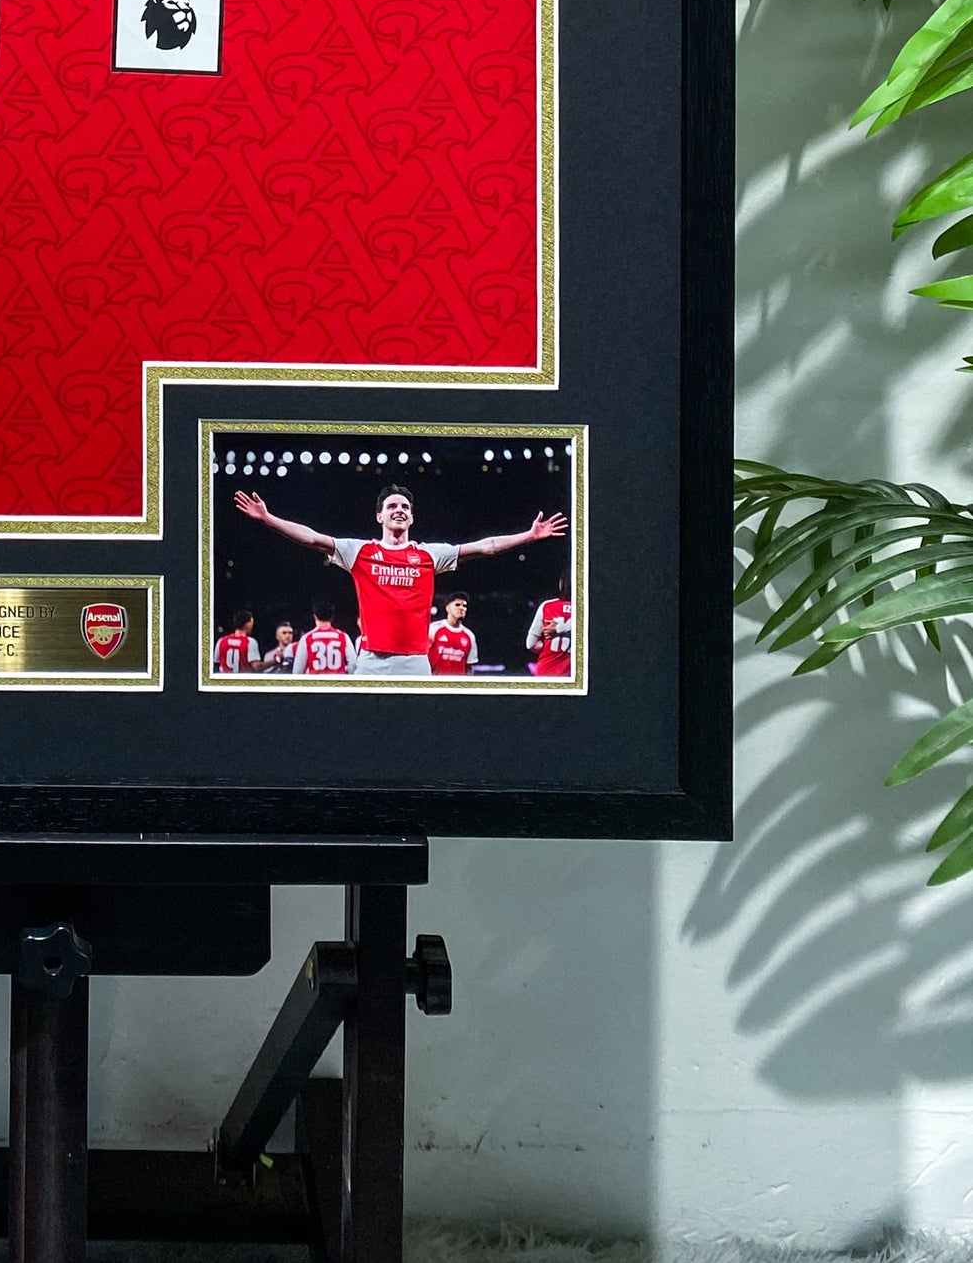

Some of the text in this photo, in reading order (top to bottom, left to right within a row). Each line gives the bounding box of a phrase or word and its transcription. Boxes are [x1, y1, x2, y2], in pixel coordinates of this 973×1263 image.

[371, 564, 421, 577] Emirates
[378, 576, 414, 586] FLY BETTER
[39, 606, 56, 618] BY
[87, 612, 121, 623] Arsenal
[310, 641, 342, 671] 36
